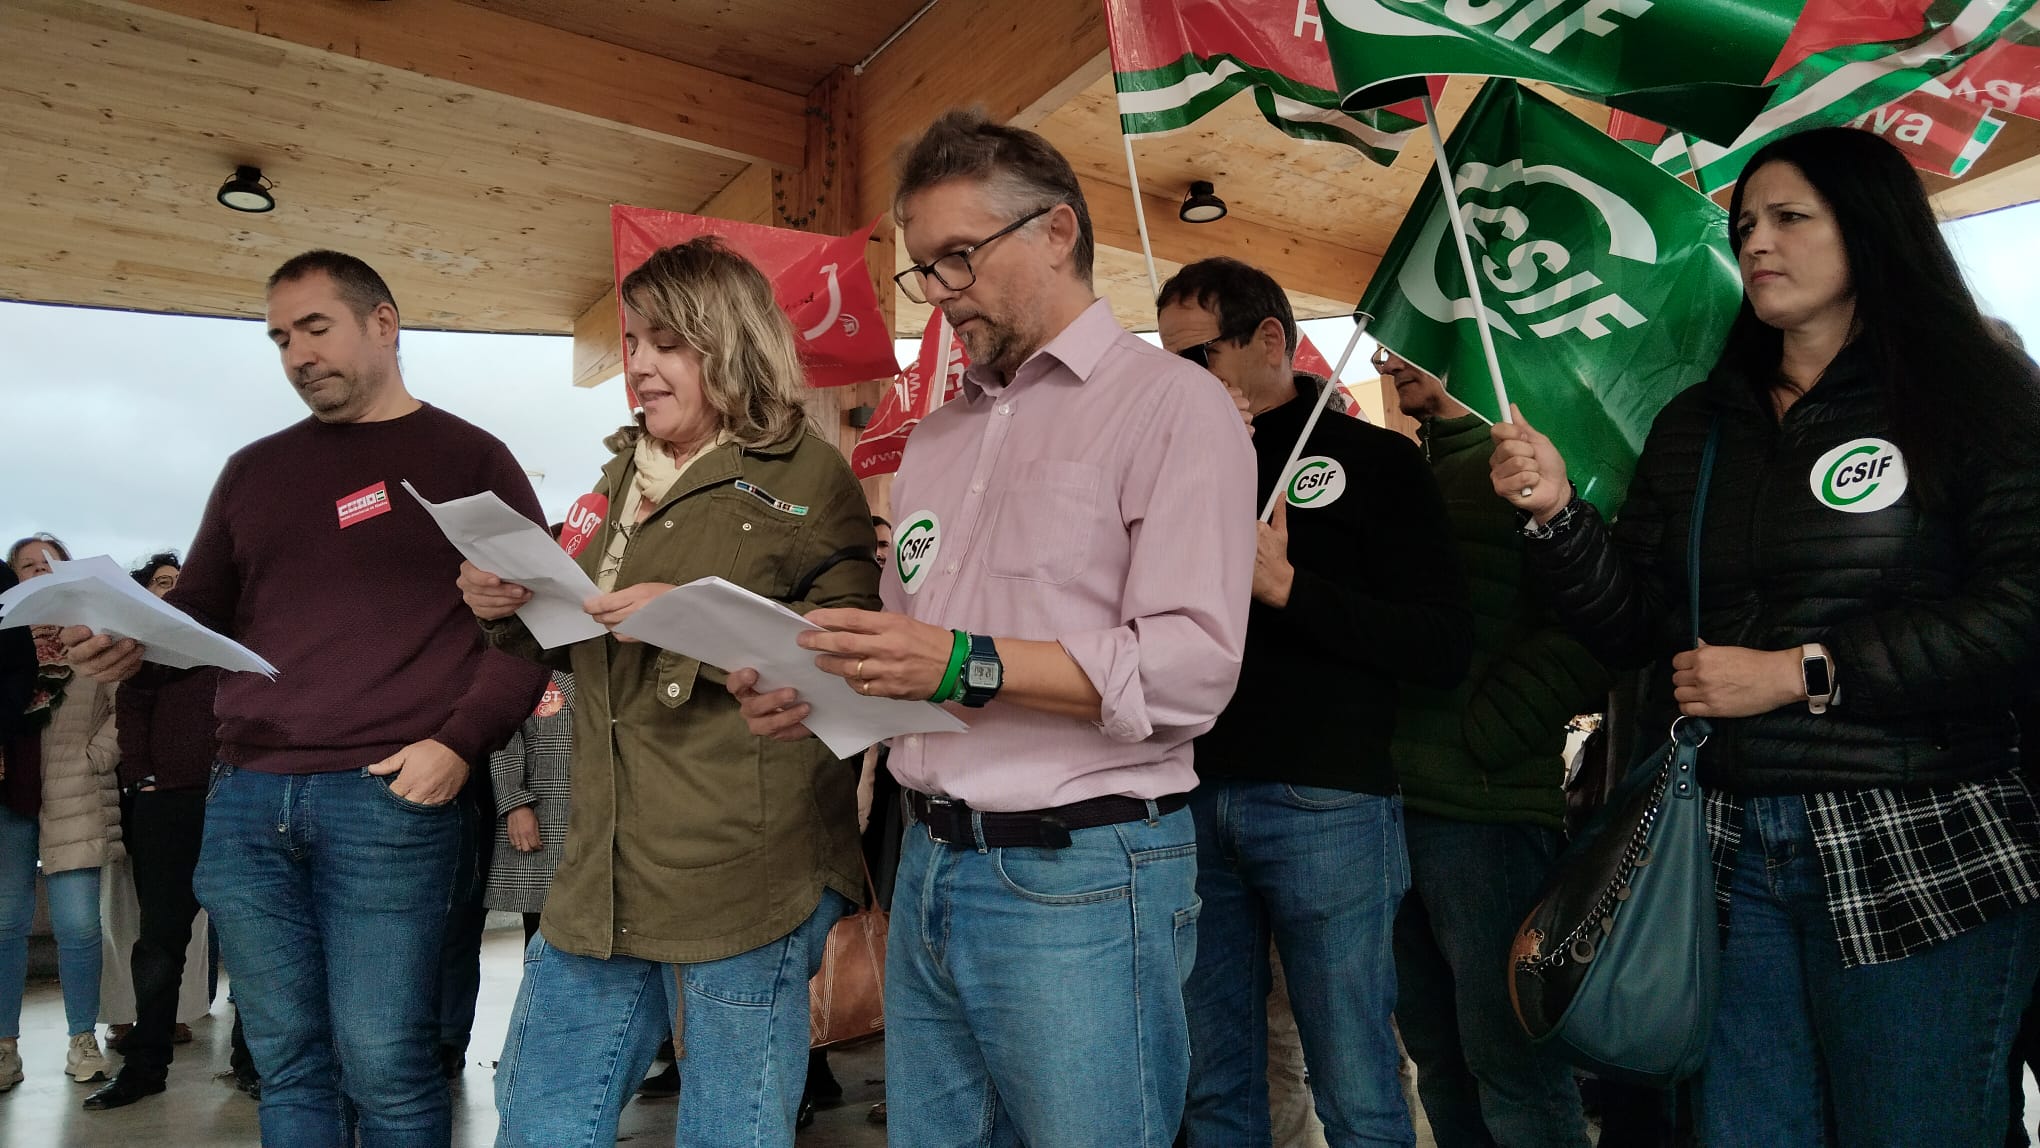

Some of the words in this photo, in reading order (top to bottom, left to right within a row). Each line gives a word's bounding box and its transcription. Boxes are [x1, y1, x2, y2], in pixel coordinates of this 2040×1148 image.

[1297, 470, 1337, 491] CSIF
[1836, 455, 1894, 488] CSIF
[569, 502, 602, 538] UGT
[901, 536, 936, 562] CSIF
